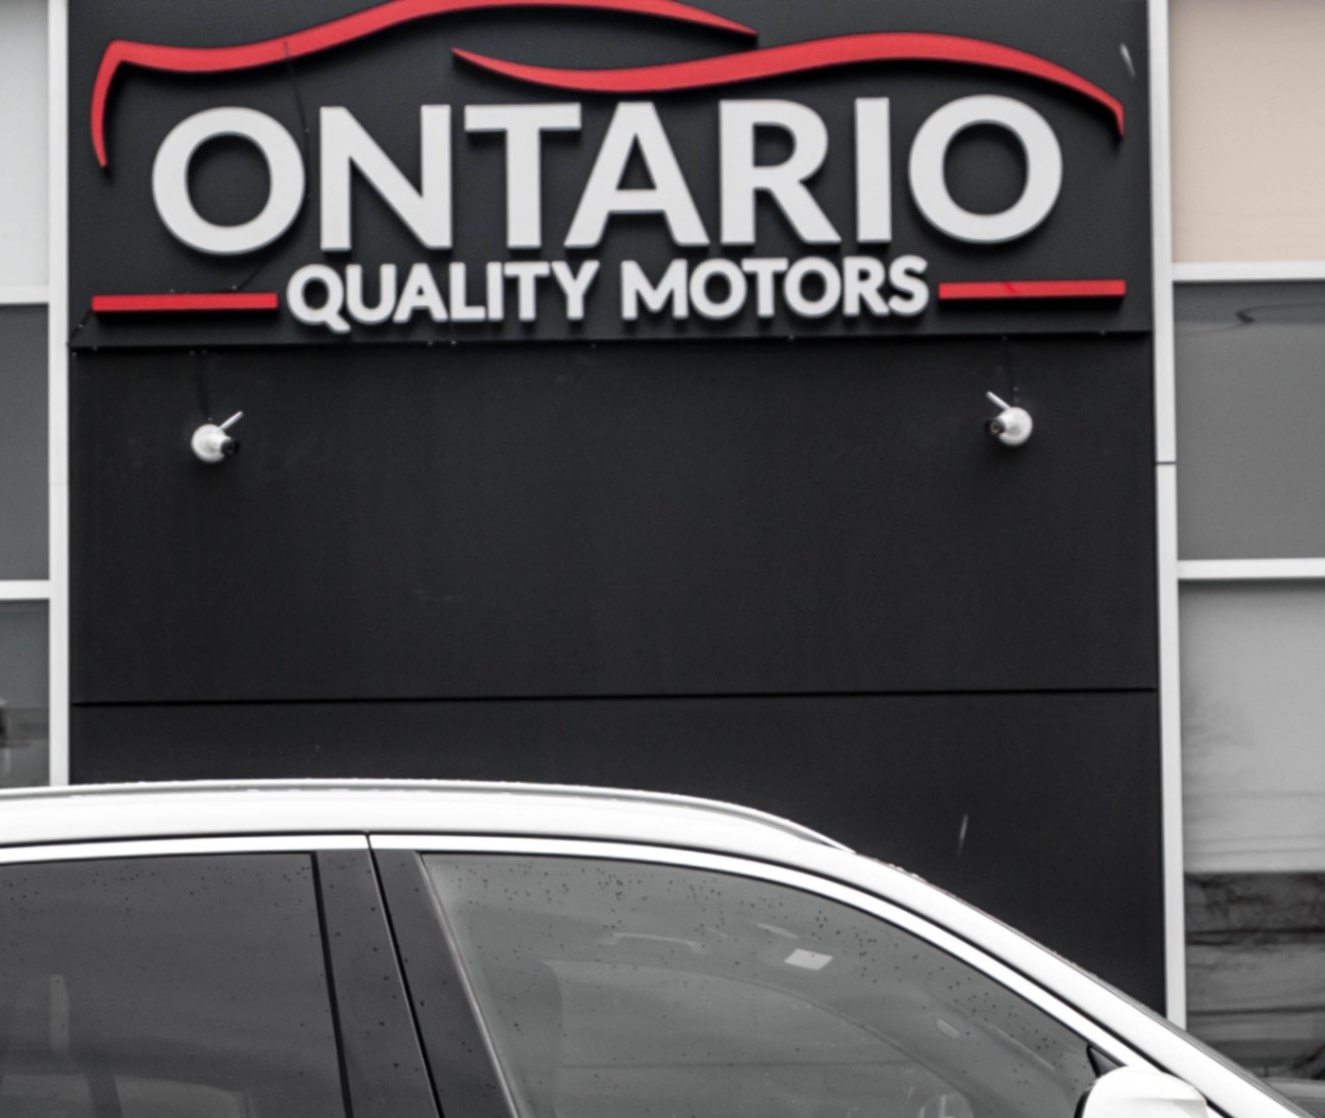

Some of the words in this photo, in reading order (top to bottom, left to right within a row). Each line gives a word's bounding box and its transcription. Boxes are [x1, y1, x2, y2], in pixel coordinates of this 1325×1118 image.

[152, 94, 1063, 254] ONTARIO
[286, 261, 600, 332] QUALITY
[620, 255, 929, 320] MOTORS
